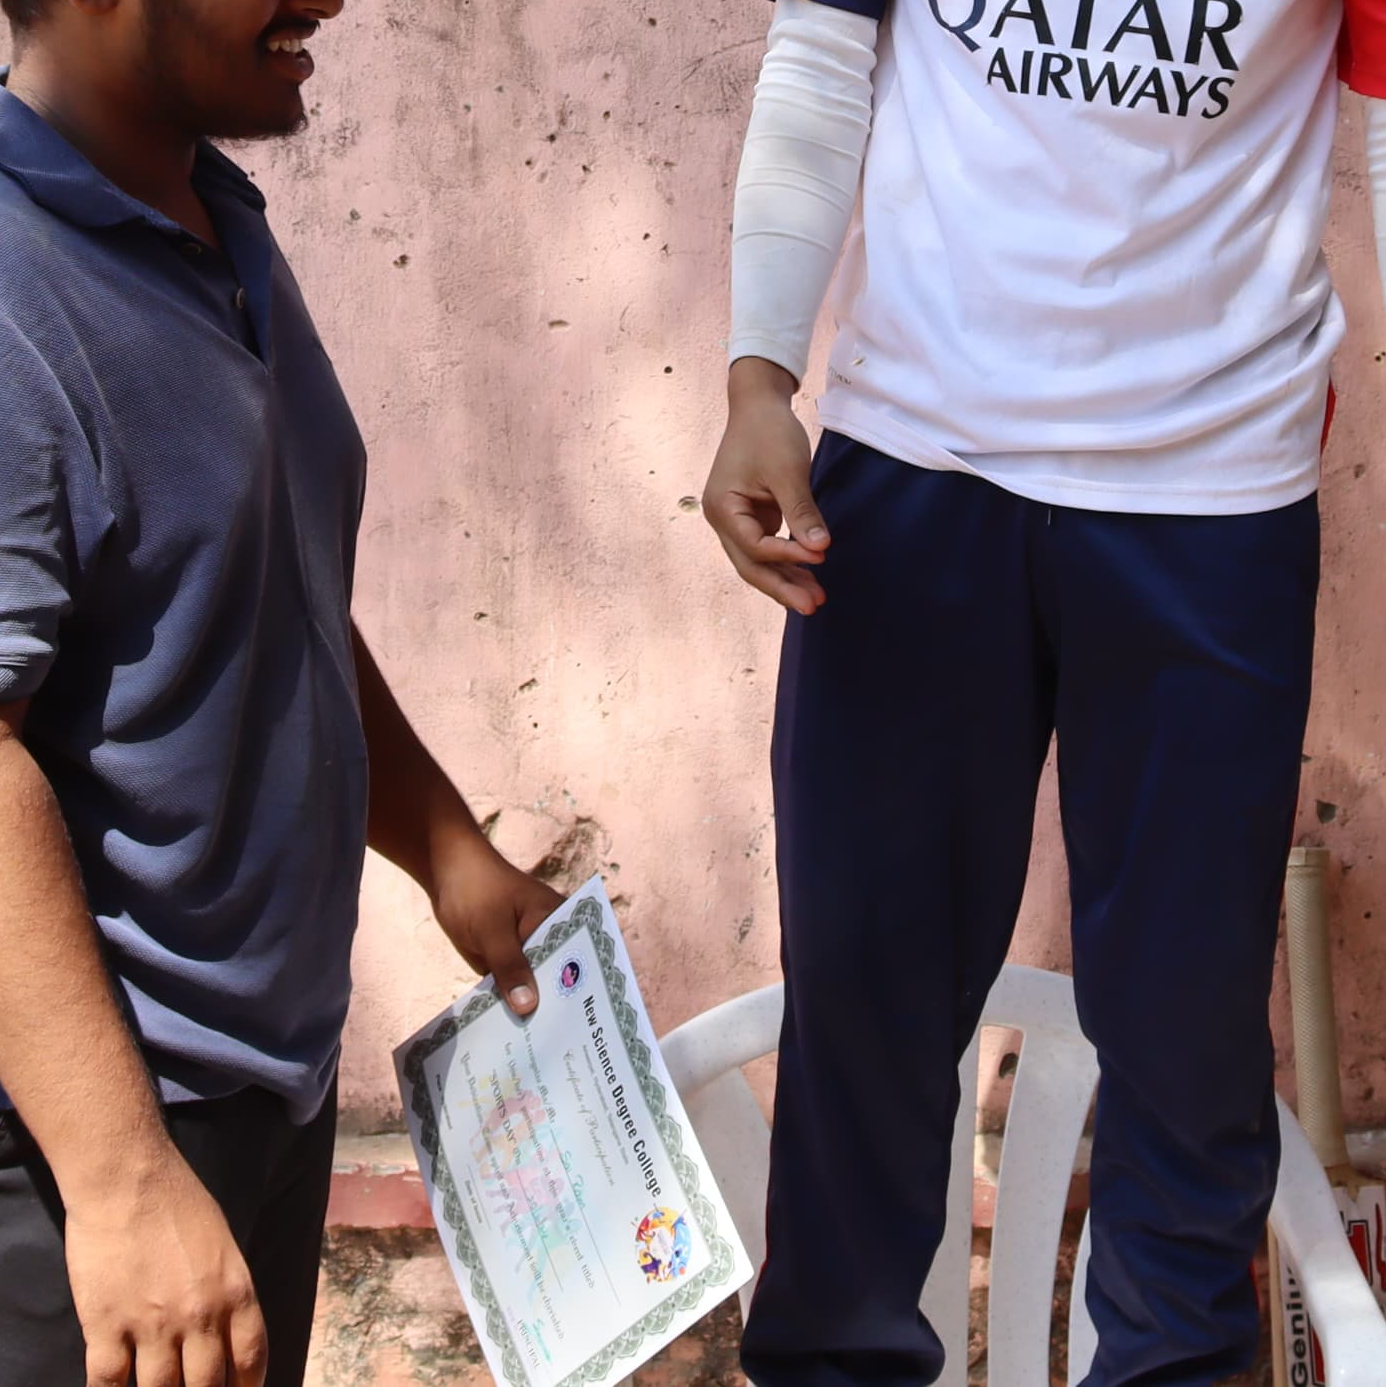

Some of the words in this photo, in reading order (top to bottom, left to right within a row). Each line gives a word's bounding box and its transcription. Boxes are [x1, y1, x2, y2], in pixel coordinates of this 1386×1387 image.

[987, 47, 1235, 120] AIRWAYS
[581, 993, 600, 1029] New
[590, 1025, 619, 1086] Science
[557, 1046, 590, 1106] Certificate
[581, 1110, 621, 1190] Participation
[609, 1083, 639, 1142] Degree
[632, 1137, 663, 1201] College
[516, 1317, 541, 1371] PRINCIPAL
[1286, 1267, 1309, 1387] Geni
